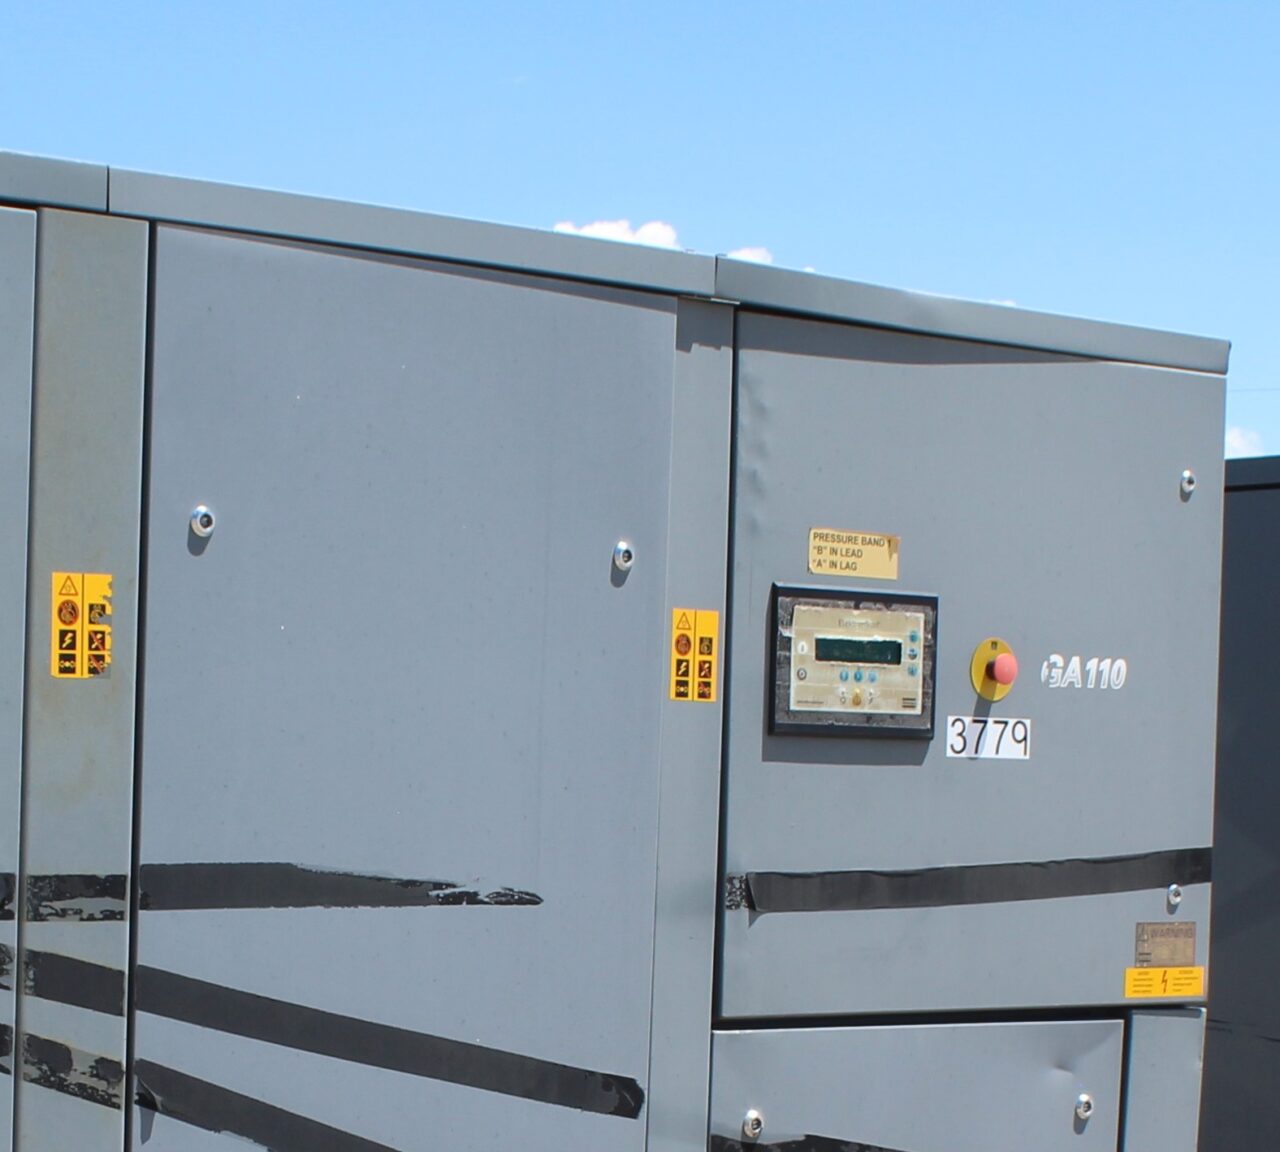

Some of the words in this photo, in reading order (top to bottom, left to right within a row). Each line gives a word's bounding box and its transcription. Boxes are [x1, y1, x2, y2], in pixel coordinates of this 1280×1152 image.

[813, 532, 859, 545] PRESSURE
[861, 536, 885, 547] BAND
[813, 546, 828, 556] "B"
[829, 546, 838, 556] IN
[840, 547, 863, 558] LEAD
[813, 559, 827, 568] "A"
[829, 559, 837, 569] IN
[840, 560, 858, 571] LAG
[949, 717, 1028, 757] 3779
[1151, 927, 1193, 939] WARNING
